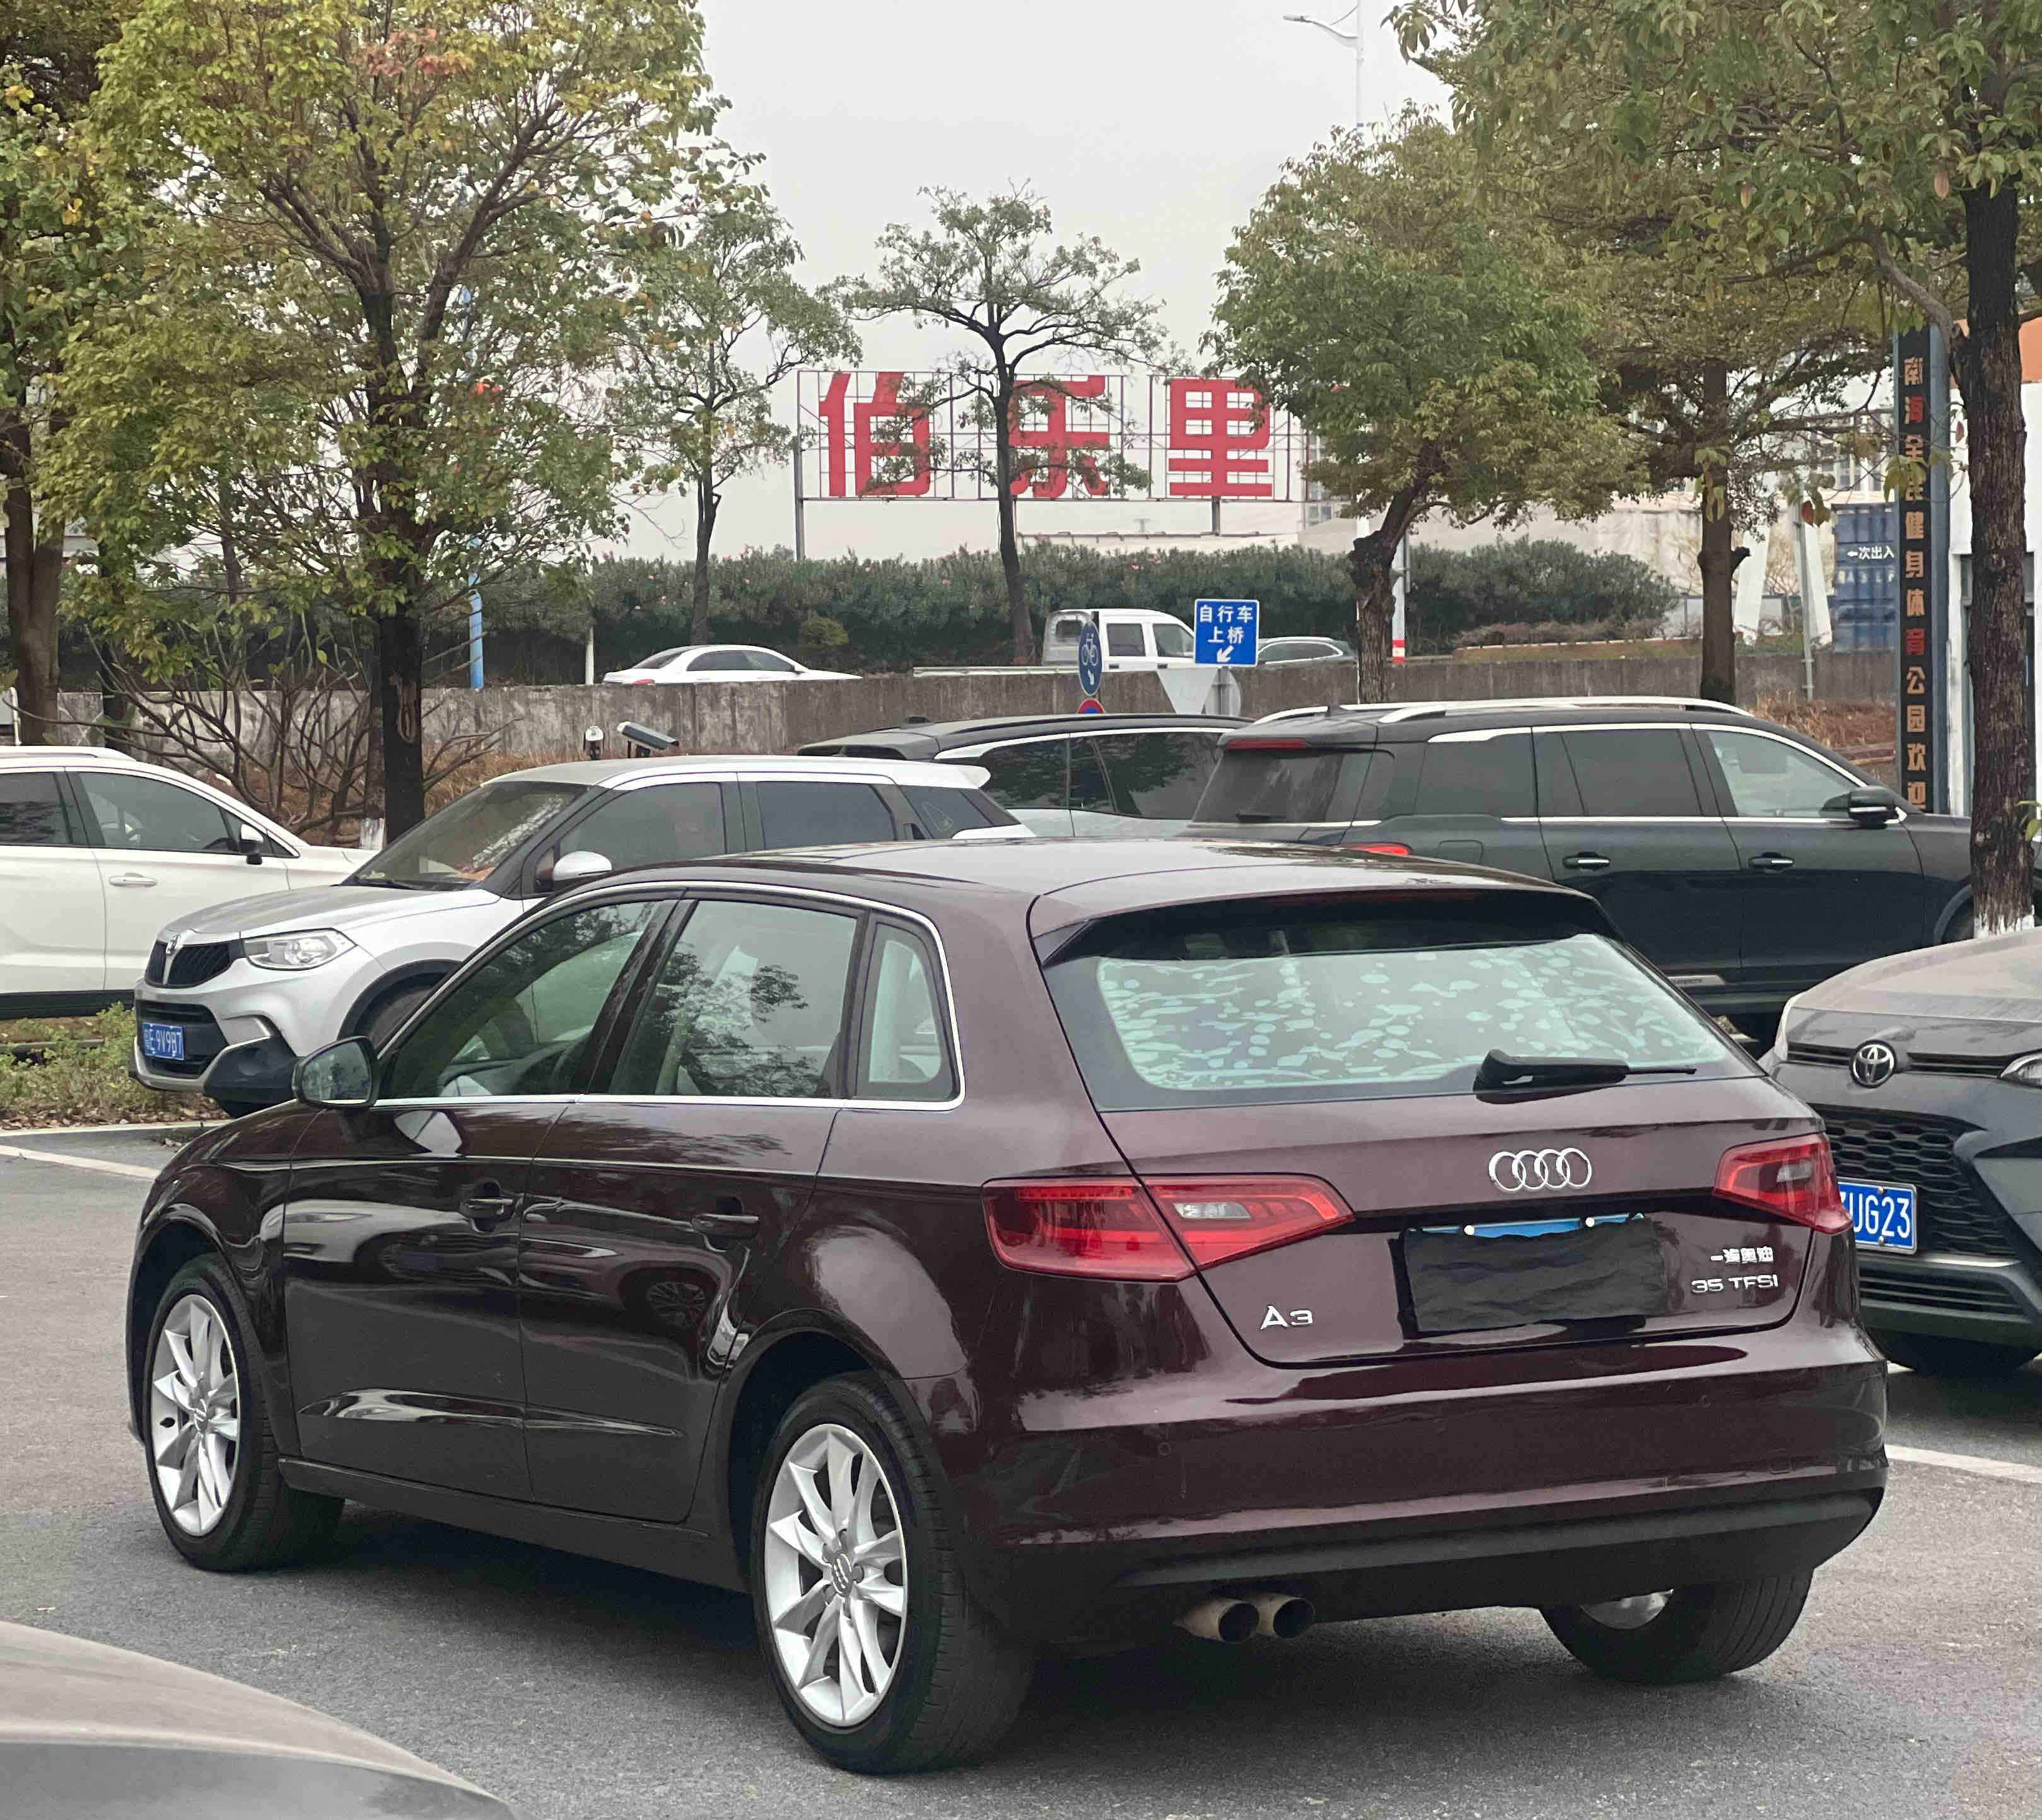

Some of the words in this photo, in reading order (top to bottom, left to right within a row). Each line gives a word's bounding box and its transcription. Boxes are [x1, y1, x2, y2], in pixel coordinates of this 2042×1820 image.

[819, 371, 1273, 498] 伯乐里
[1858, 545, 1894, 560] 次出入
[1199, 605, 1253, 624] 自行车
[1207, 626, 1244, 645] 上桥
[1839, 1191, 1911, 1239] UG23
[1710, 1245, 1774, 1264] 一汽奥迪
[1691, 1278, 1725, 1294] 35
[1728, 1273, 1779, 1290] TFSI
[1259, 1305, 1314, 1330] A3
